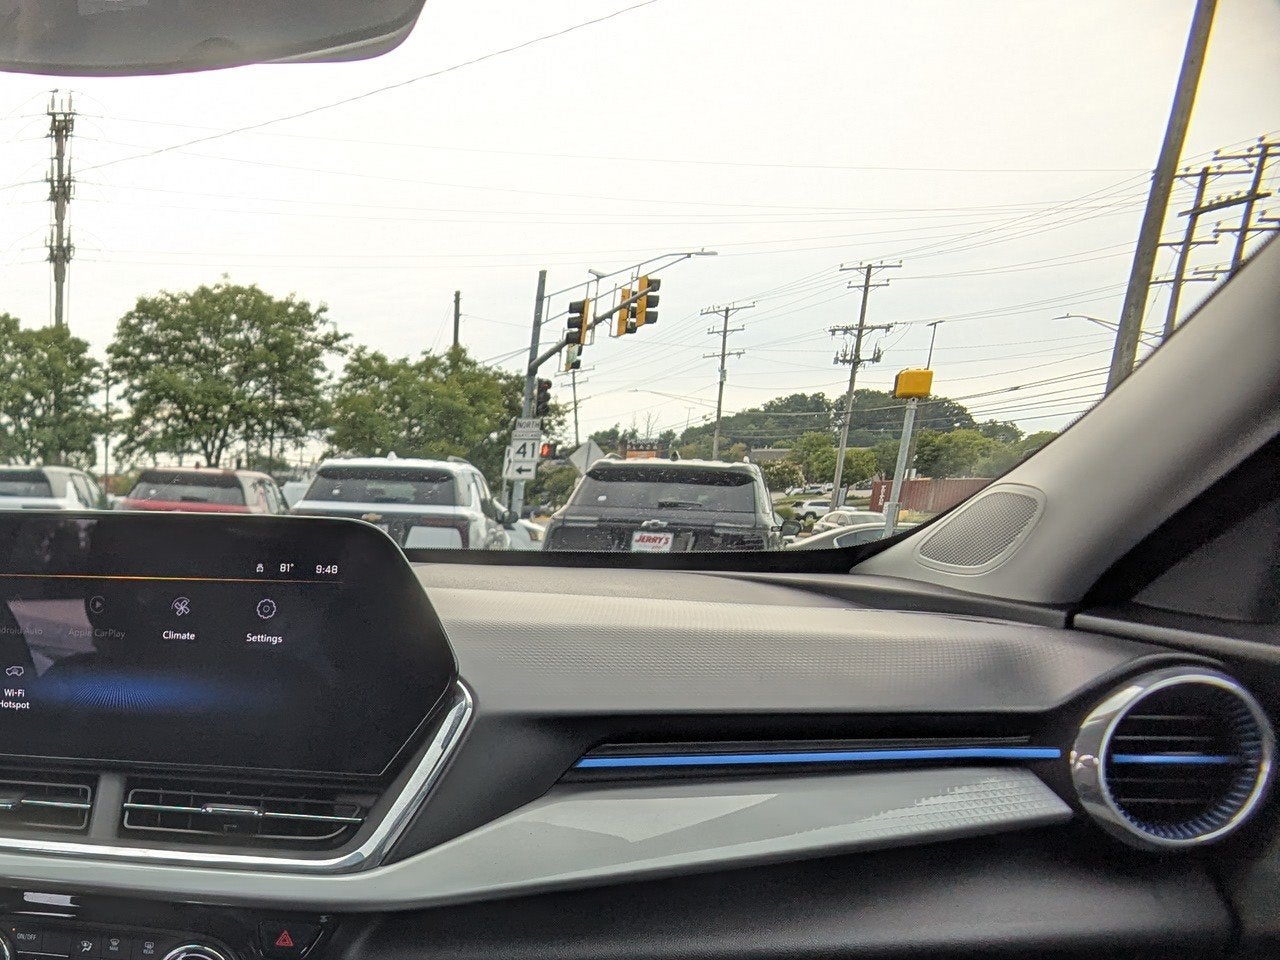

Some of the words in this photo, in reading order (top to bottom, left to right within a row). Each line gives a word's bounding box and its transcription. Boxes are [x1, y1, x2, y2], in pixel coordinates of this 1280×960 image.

[516, 420, 540, 429] NORTH
[516, 442, 536, 459] 41
[635, 535, 670, 545] JERRY'S
[315, 565, 339, 575] 9:48
[23, 627, 44, 636] Auto
[68, 628, 92, 639] Apple
[94, 629, 126, 640] CarPlay
[162, 630, 196, 641] Climate
[246, 633, 283, 645] Settings
[3, 688, 26, 698] Wi-Fi
[16, 932, 38, 941] ON/OFF
